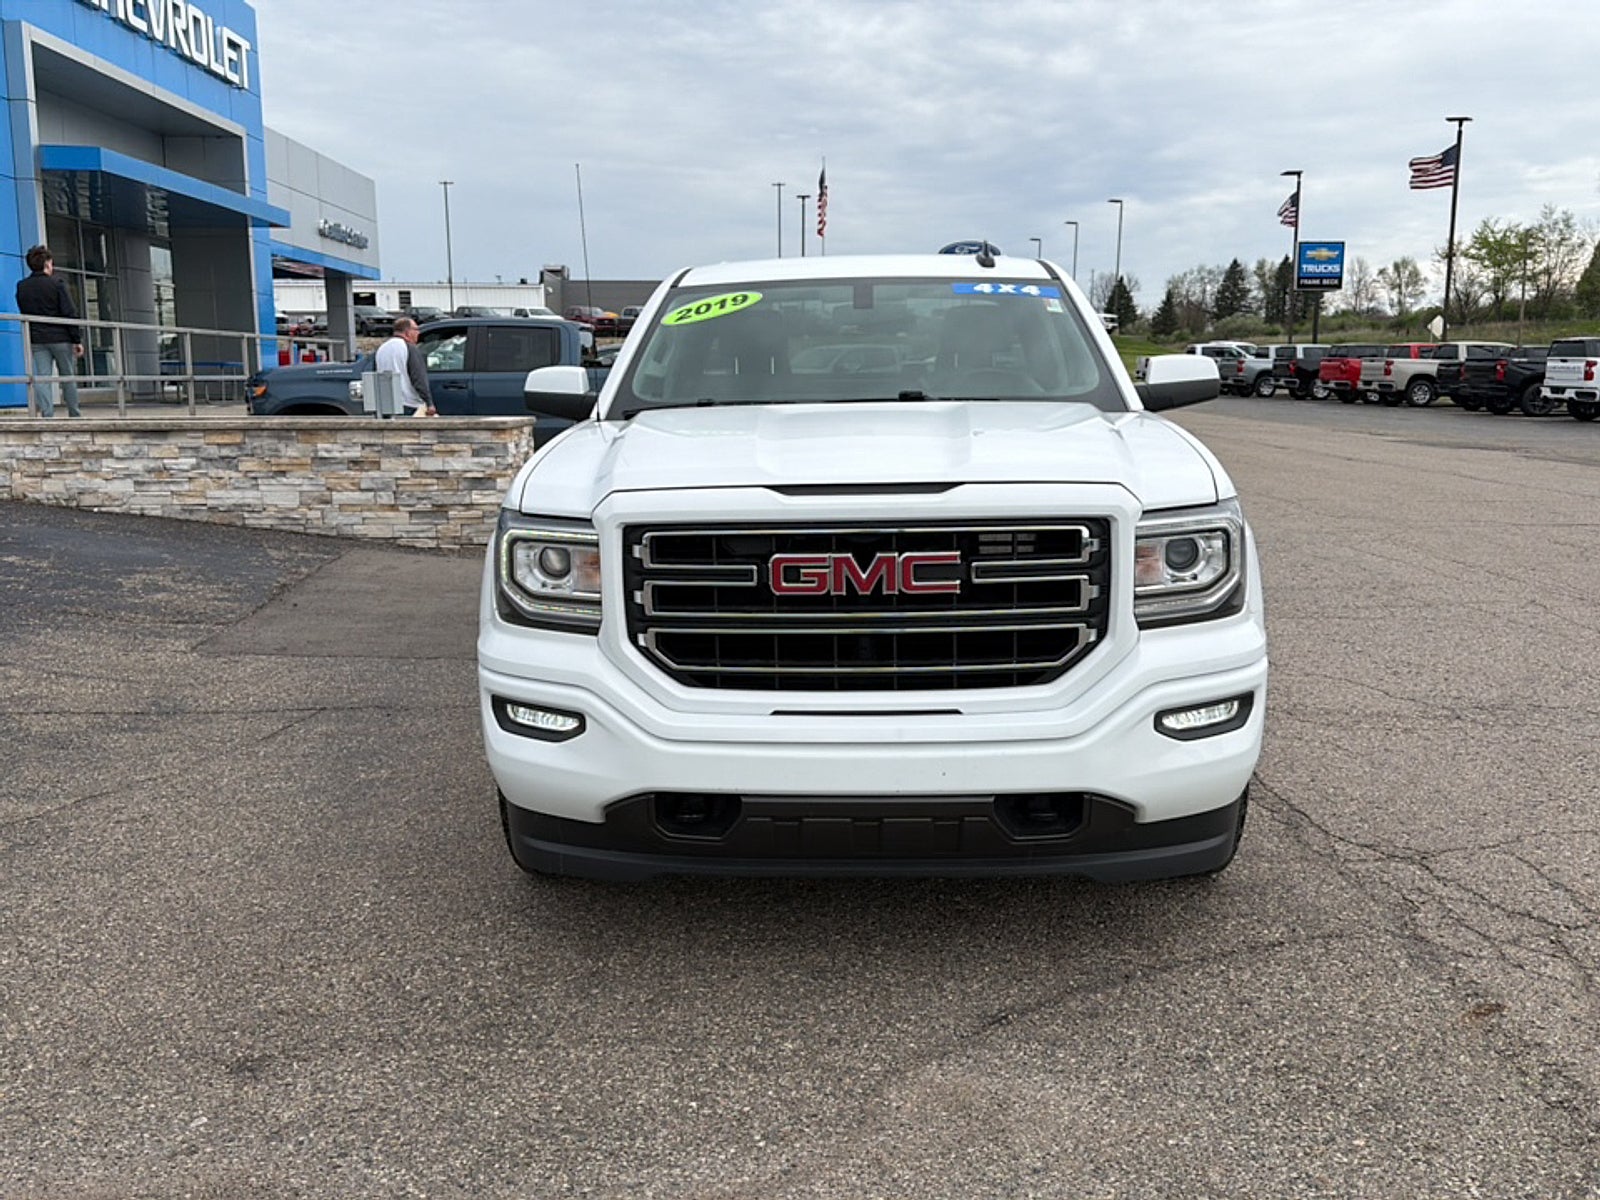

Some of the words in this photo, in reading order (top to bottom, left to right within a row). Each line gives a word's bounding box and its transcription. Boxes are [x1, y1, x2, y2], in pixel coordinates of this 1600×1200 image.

[90, 0, 250, 89] EVROLET
[1302, 263, 1341, 273] TRUCKS
[674, 294, 749, 323] 2019
[769, 551, 962, 596] GMC
